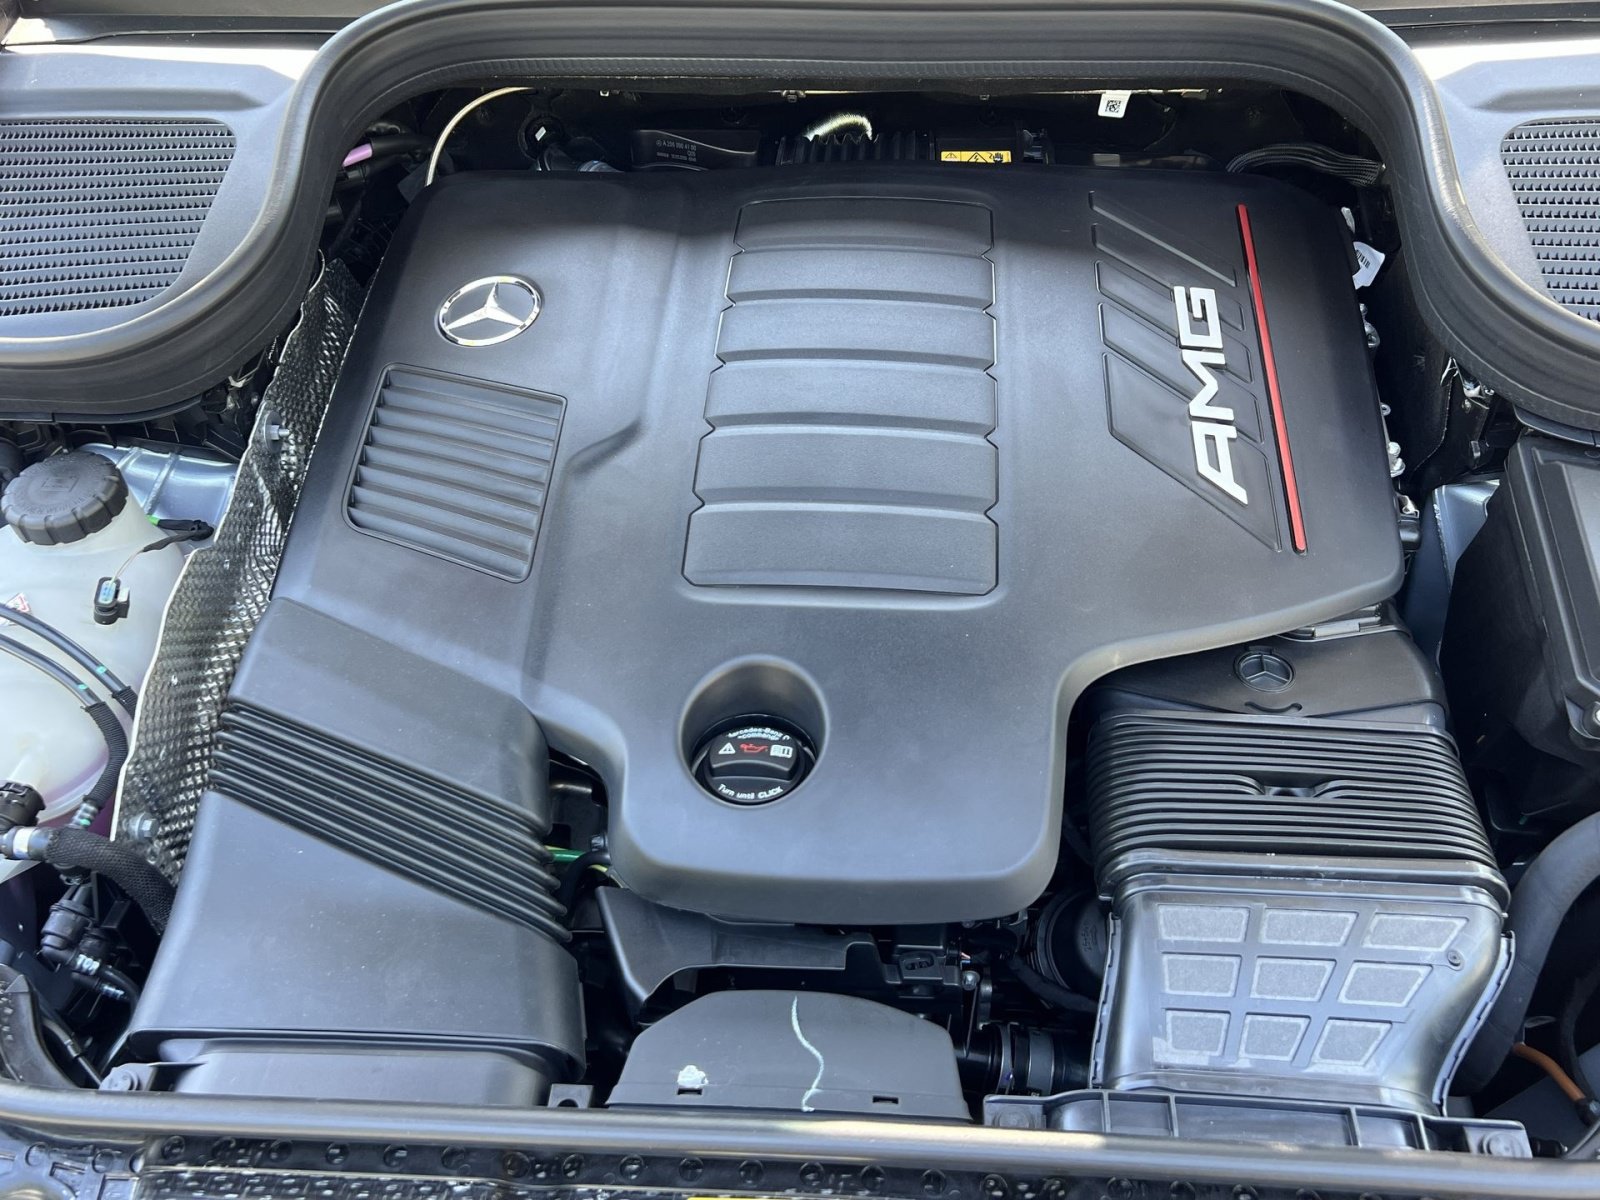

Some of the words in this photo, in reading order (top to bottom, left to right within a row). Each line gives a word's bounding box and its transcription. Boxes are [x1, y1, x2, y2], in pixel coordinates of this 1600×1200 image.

[1173, 286, 1248, 505] AMG
[719, 784, 734, 796] Turn
[758, 786, 783, 798] CLICK
